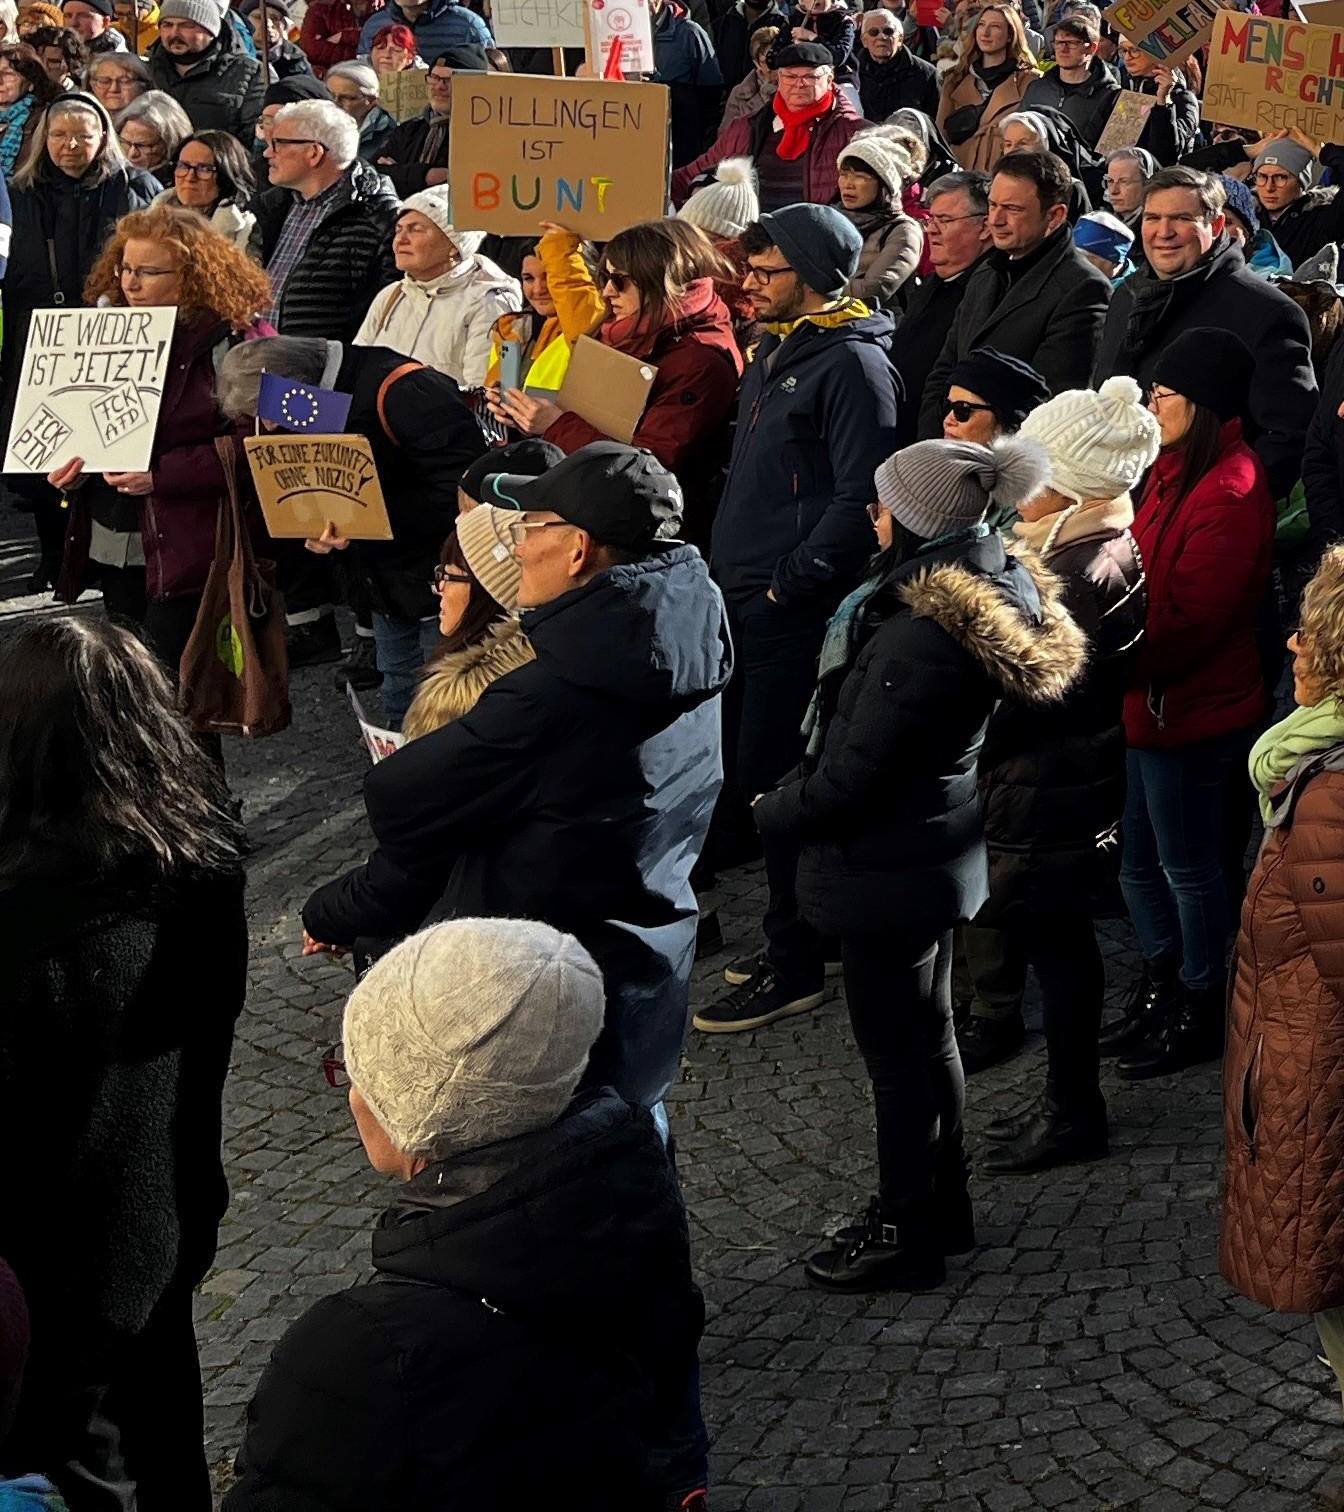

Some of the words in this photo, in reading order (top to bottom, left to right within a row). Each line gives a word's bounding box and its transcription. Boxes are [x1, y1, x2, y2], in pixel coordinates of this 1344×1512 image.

[498, 0, 584, 28] LICHKE
[471, 95, 642, 140] DILLINGEN
[1206, 83, 1250, 108] STATT
[1256, 100, 1329, 136] RECHTE
[522, 139, 563, 161] IST
[472, 172, 615, 214] BUNT
[30, 313, 72, 348] NIE
[77, 312, 153, 347] WIEDER
[28, 353, 66, 386] IST
[70, 341, 166, 383] JETZT!
[94, 386, 138, 421] FCK
[34, 409, 69, 450] FCK
[105, 409, 139, 440] AFD
[12, 429, 52, 470] PTN
[279, 444, 310, 464] EINE
[311, 443, 374, 473] ZUKUNFT
[274, 466, 311, 489] OHNE
[315, 468, 374, 496] NAZIS!
